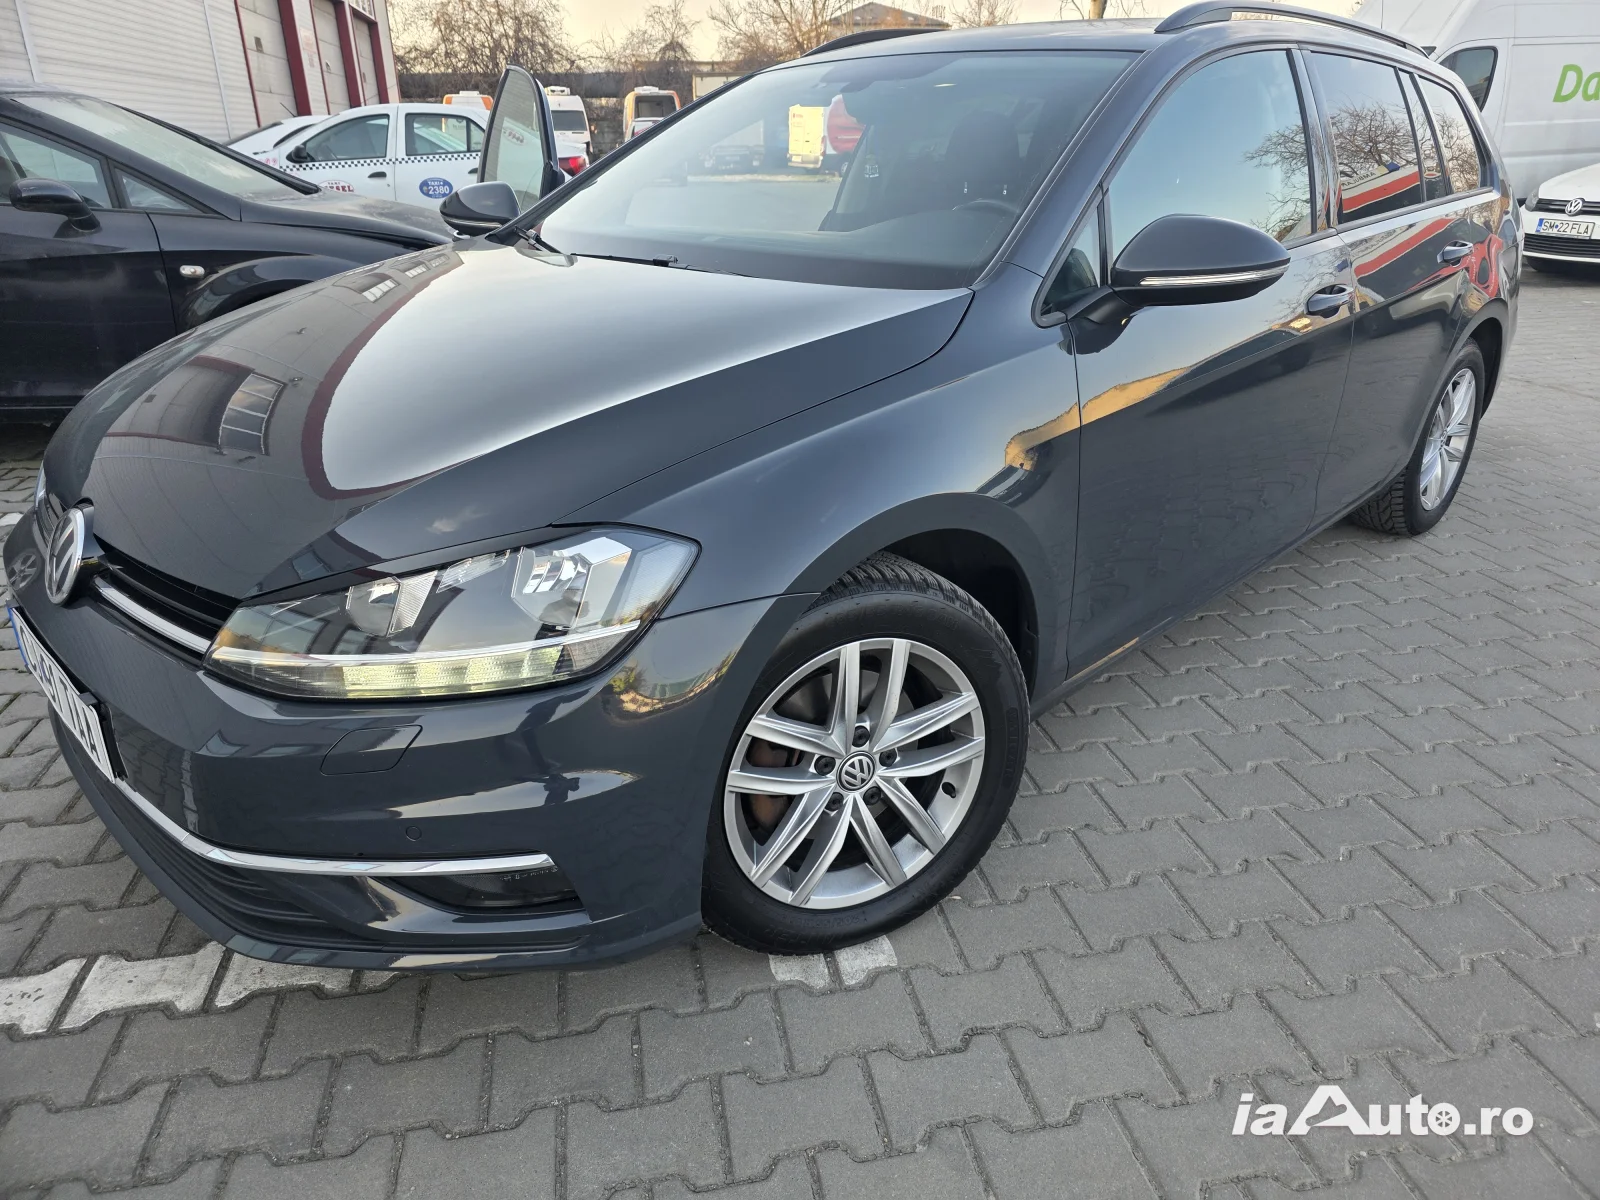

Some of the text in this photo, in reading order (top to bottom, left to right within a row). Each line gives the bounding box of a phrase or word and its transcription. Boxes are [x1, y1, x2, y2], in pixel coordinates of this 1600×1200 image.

[1553, 64, 1600, 102] Da
[428, 185, 450, 194] 2380
[1542, 221, 1589, 235] SM 22 FLA
